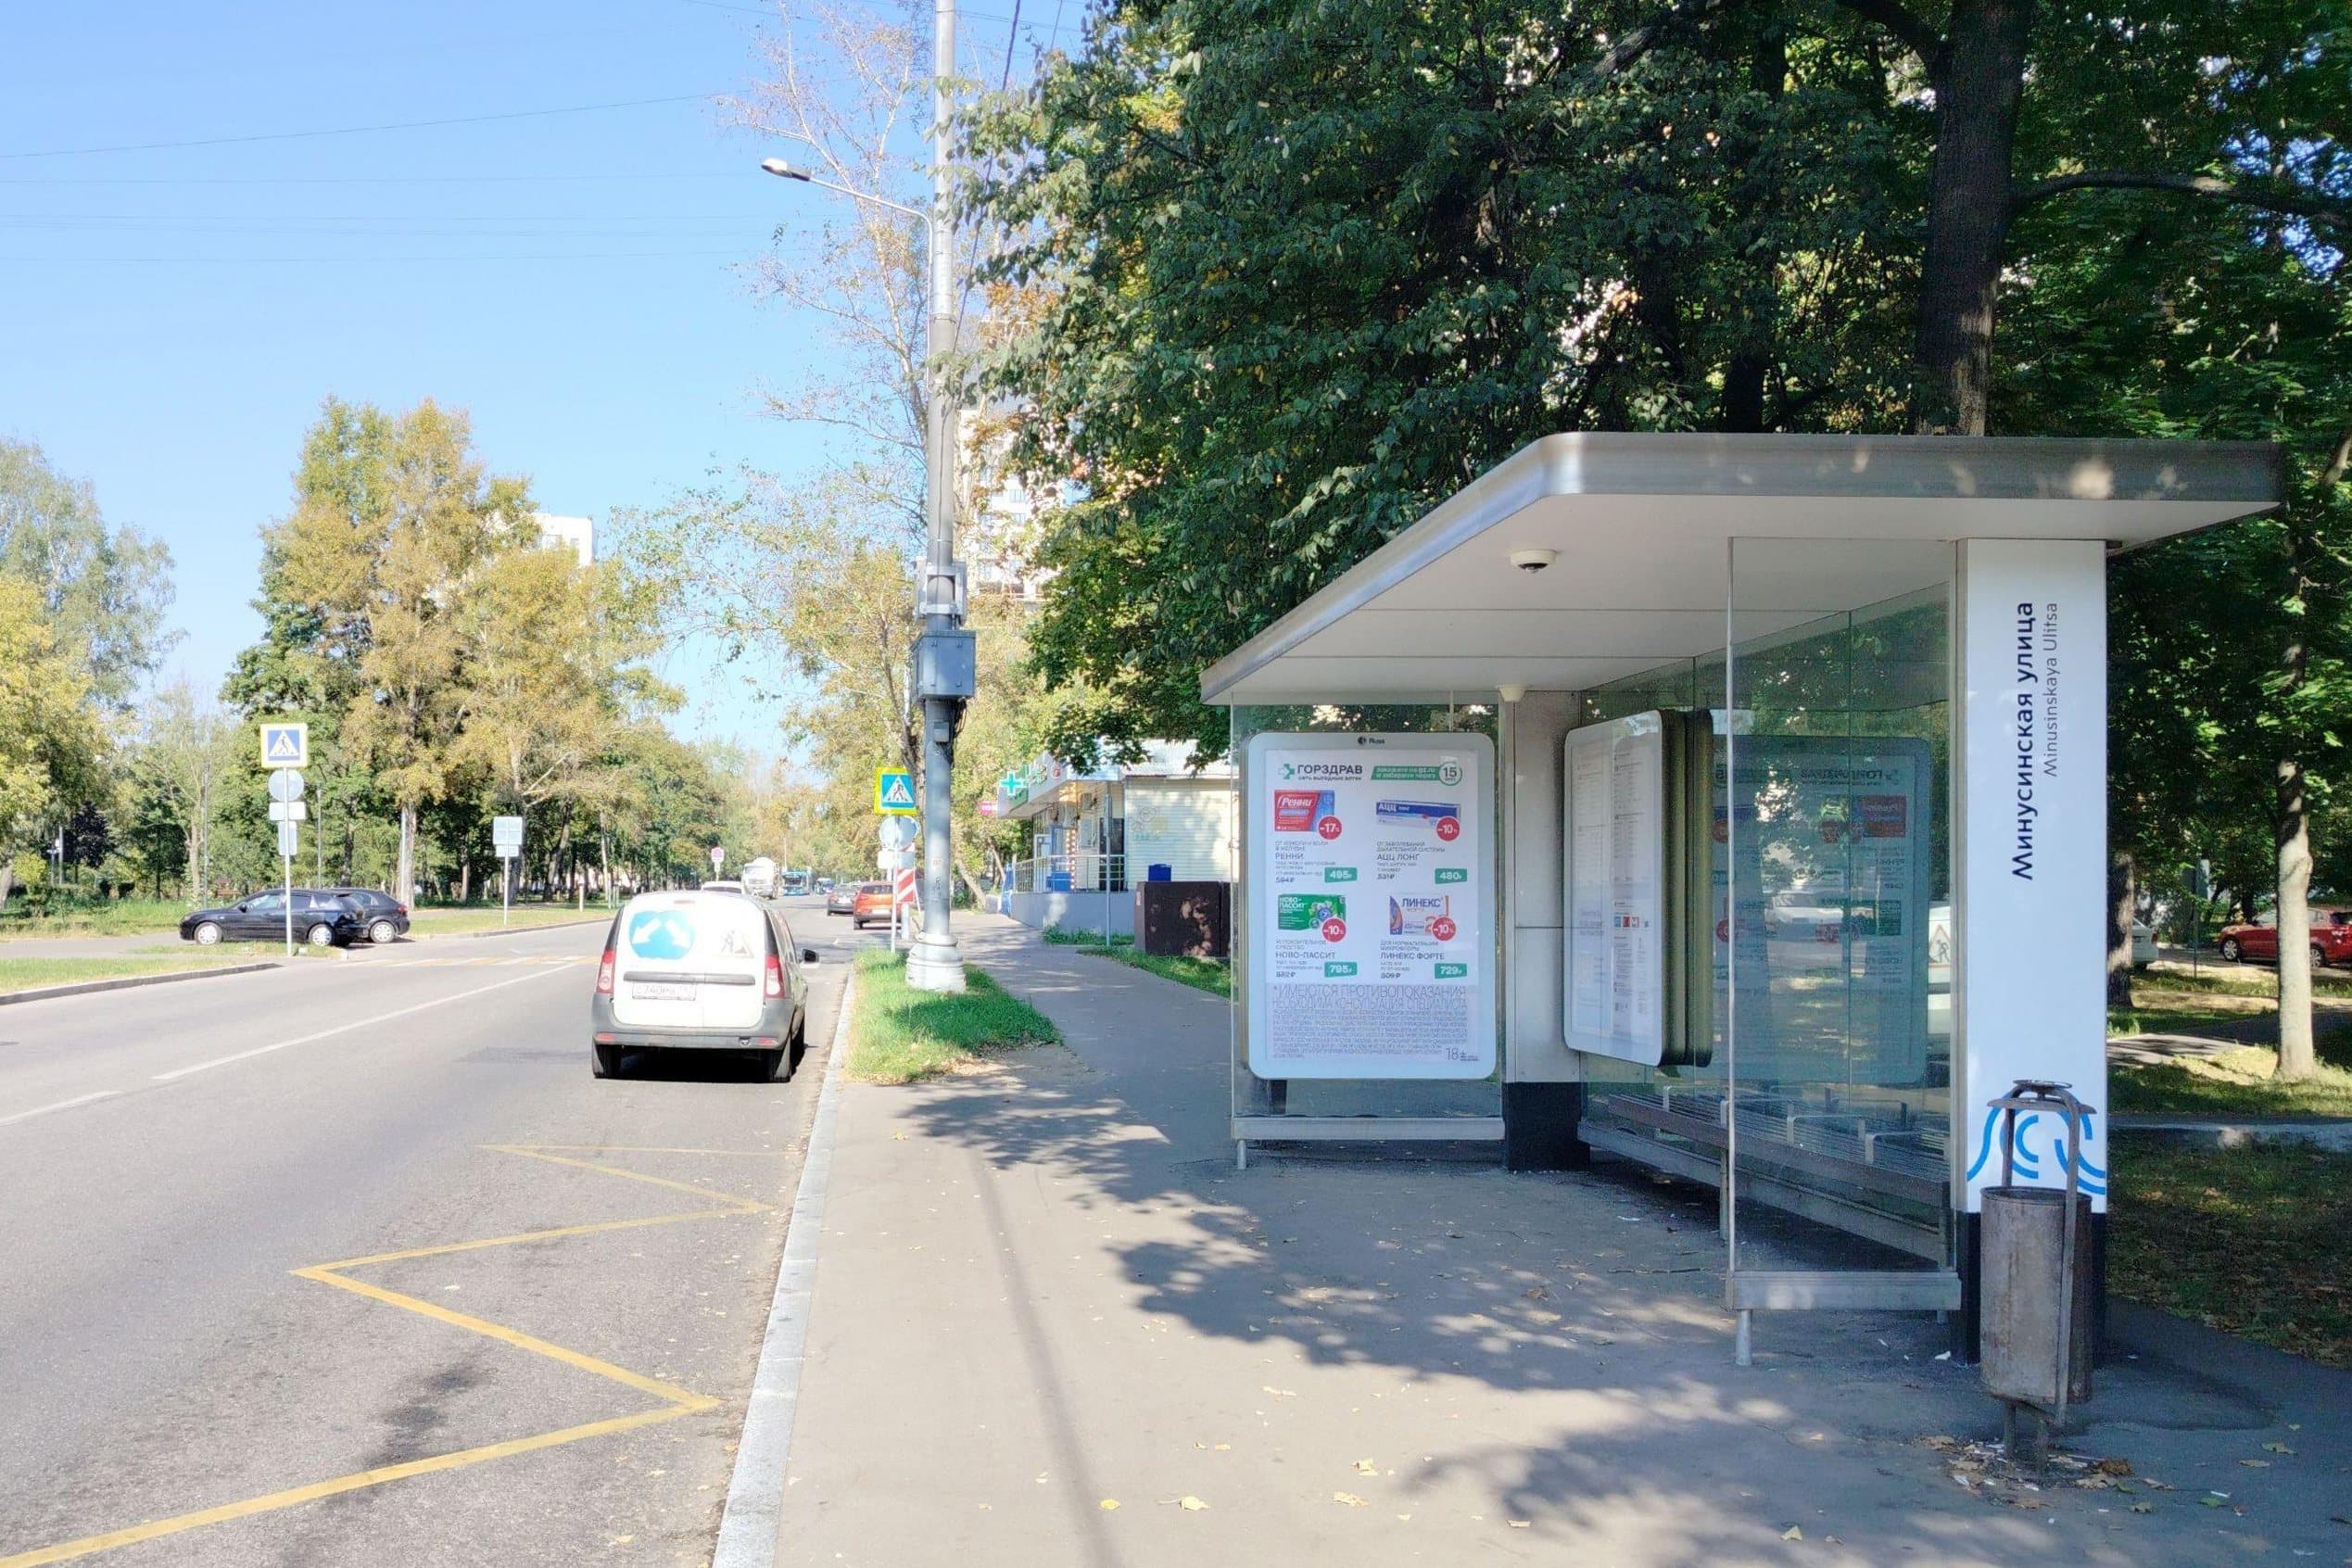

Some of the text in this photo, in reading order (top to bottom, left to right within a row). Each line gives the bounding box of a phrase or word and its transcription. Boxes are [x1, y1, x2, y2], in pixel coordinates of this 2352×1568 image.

[2043, 602, 2060, 777] Minusinskaya Ulitsa
[2012, 602, 2038, 880] Минусинская улица
[1297, 765, 1362, 776] ГОРЗДРАВ
[1442, 766, 1458, 778] 15
[1281, 797, 1313, 806] Ренни
[1378, 803, 1397, 812] АЦЦ
[1402, 898, 1441, 907] ЛИНЕКС
